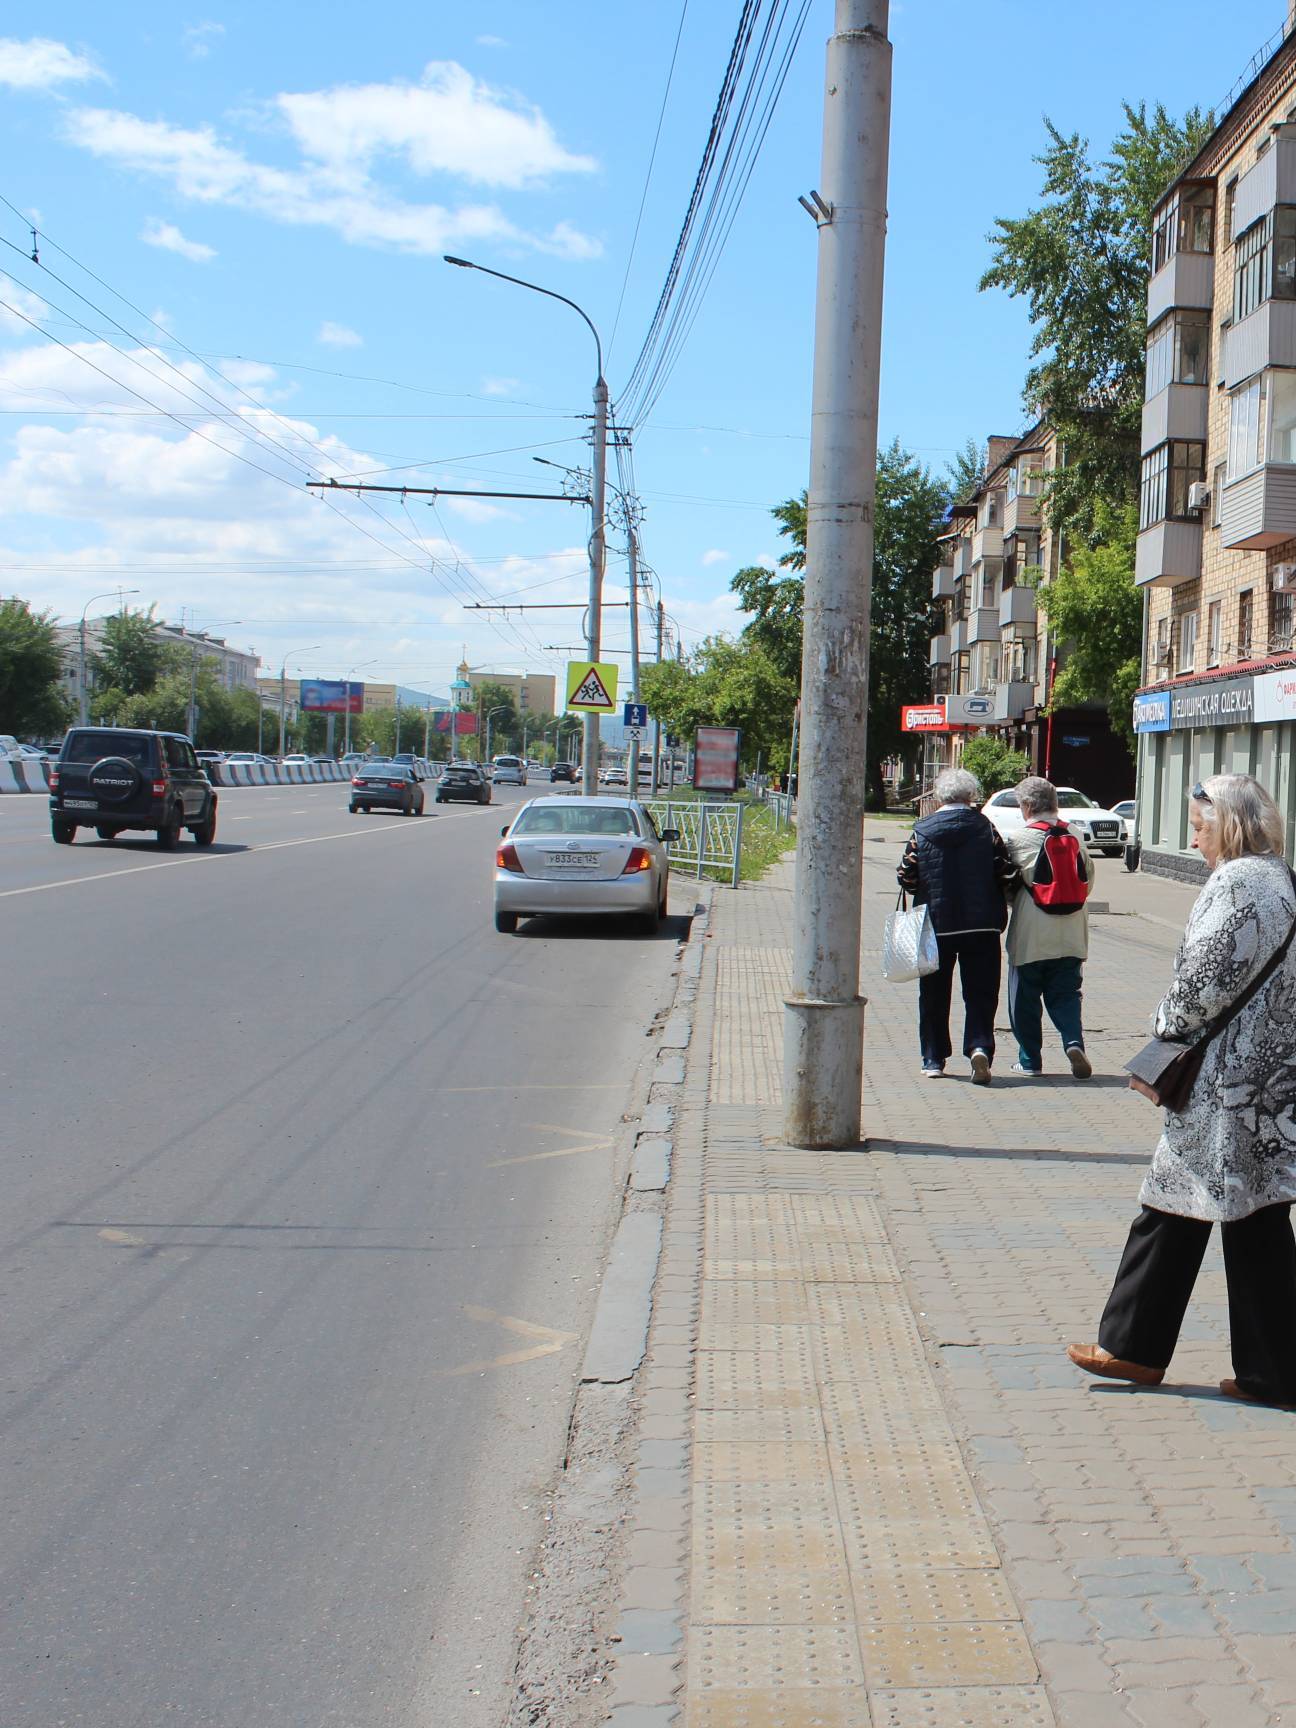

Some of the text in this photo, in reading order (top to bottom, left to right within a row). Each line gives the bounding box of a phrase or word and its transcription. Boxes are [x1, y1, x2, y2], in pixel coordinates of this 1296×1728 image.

[1172, 693, 1219, 718] МЕДИЦИНСКАЯ
[1221, 689, 1253, 713] ОДЕЖДА
[93, 778, 134, 786] PATRIOT
